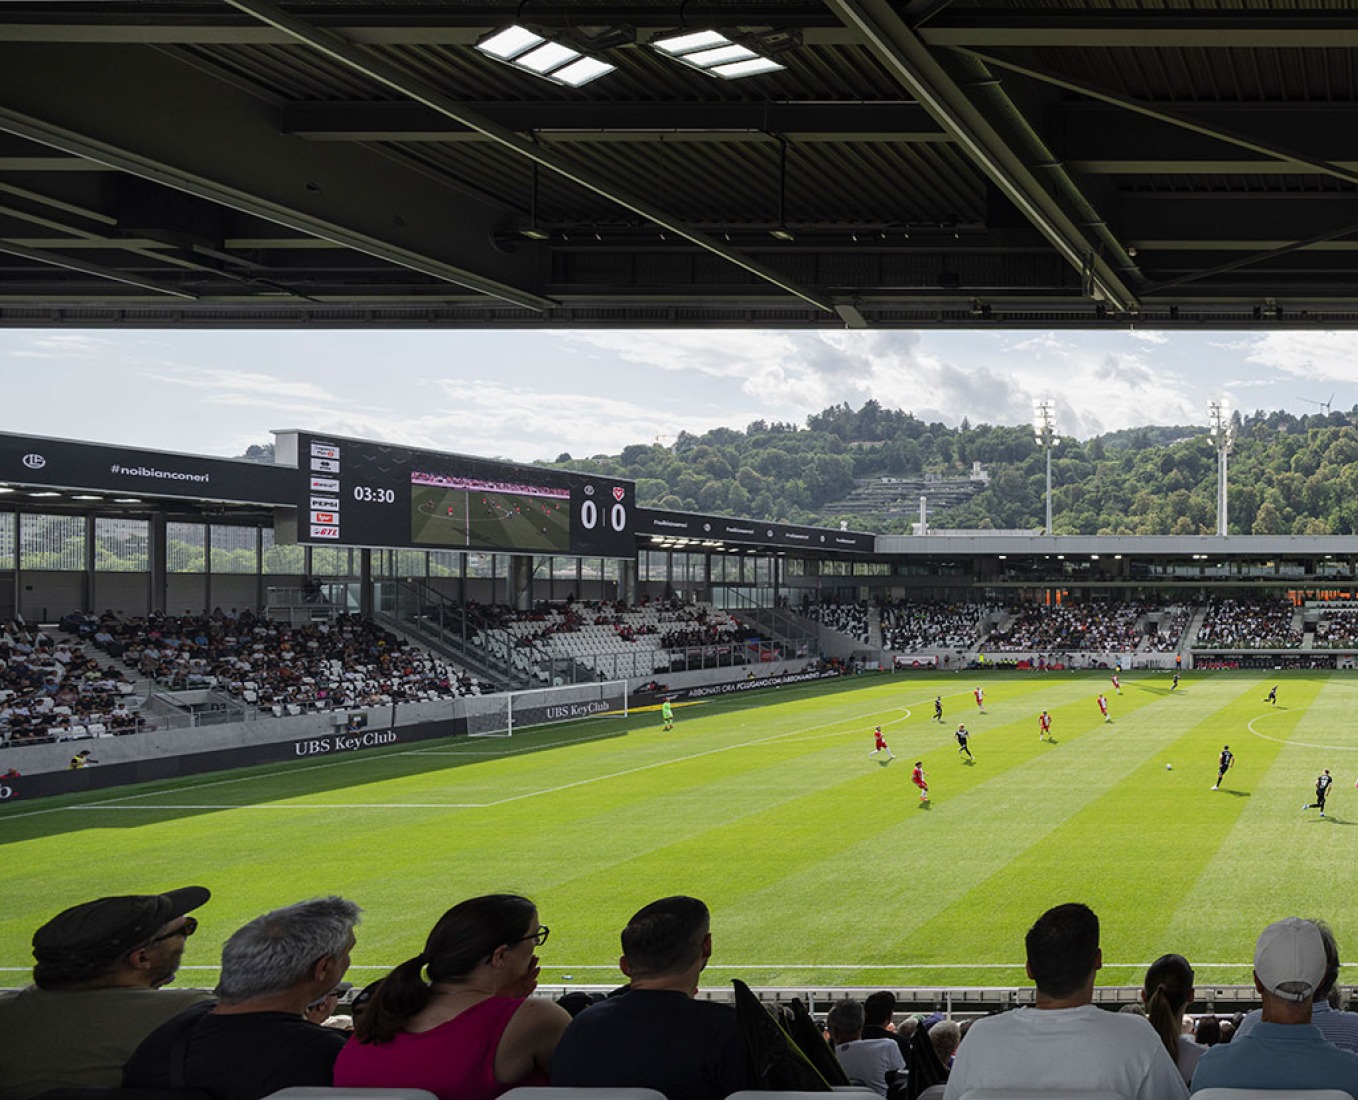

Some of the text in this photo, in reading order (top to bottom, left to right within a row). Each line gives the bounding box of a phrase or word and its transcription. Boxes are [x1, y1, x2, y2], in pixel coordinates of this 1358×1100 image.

[110, 465, 209, 483] #noibianconeri
[353, 486, 395, 503] 03:30
[581, 500, 626, 531] 0 0
[547, 705, 569, 719] UBS
[295, 738, 330, 756] UBS
